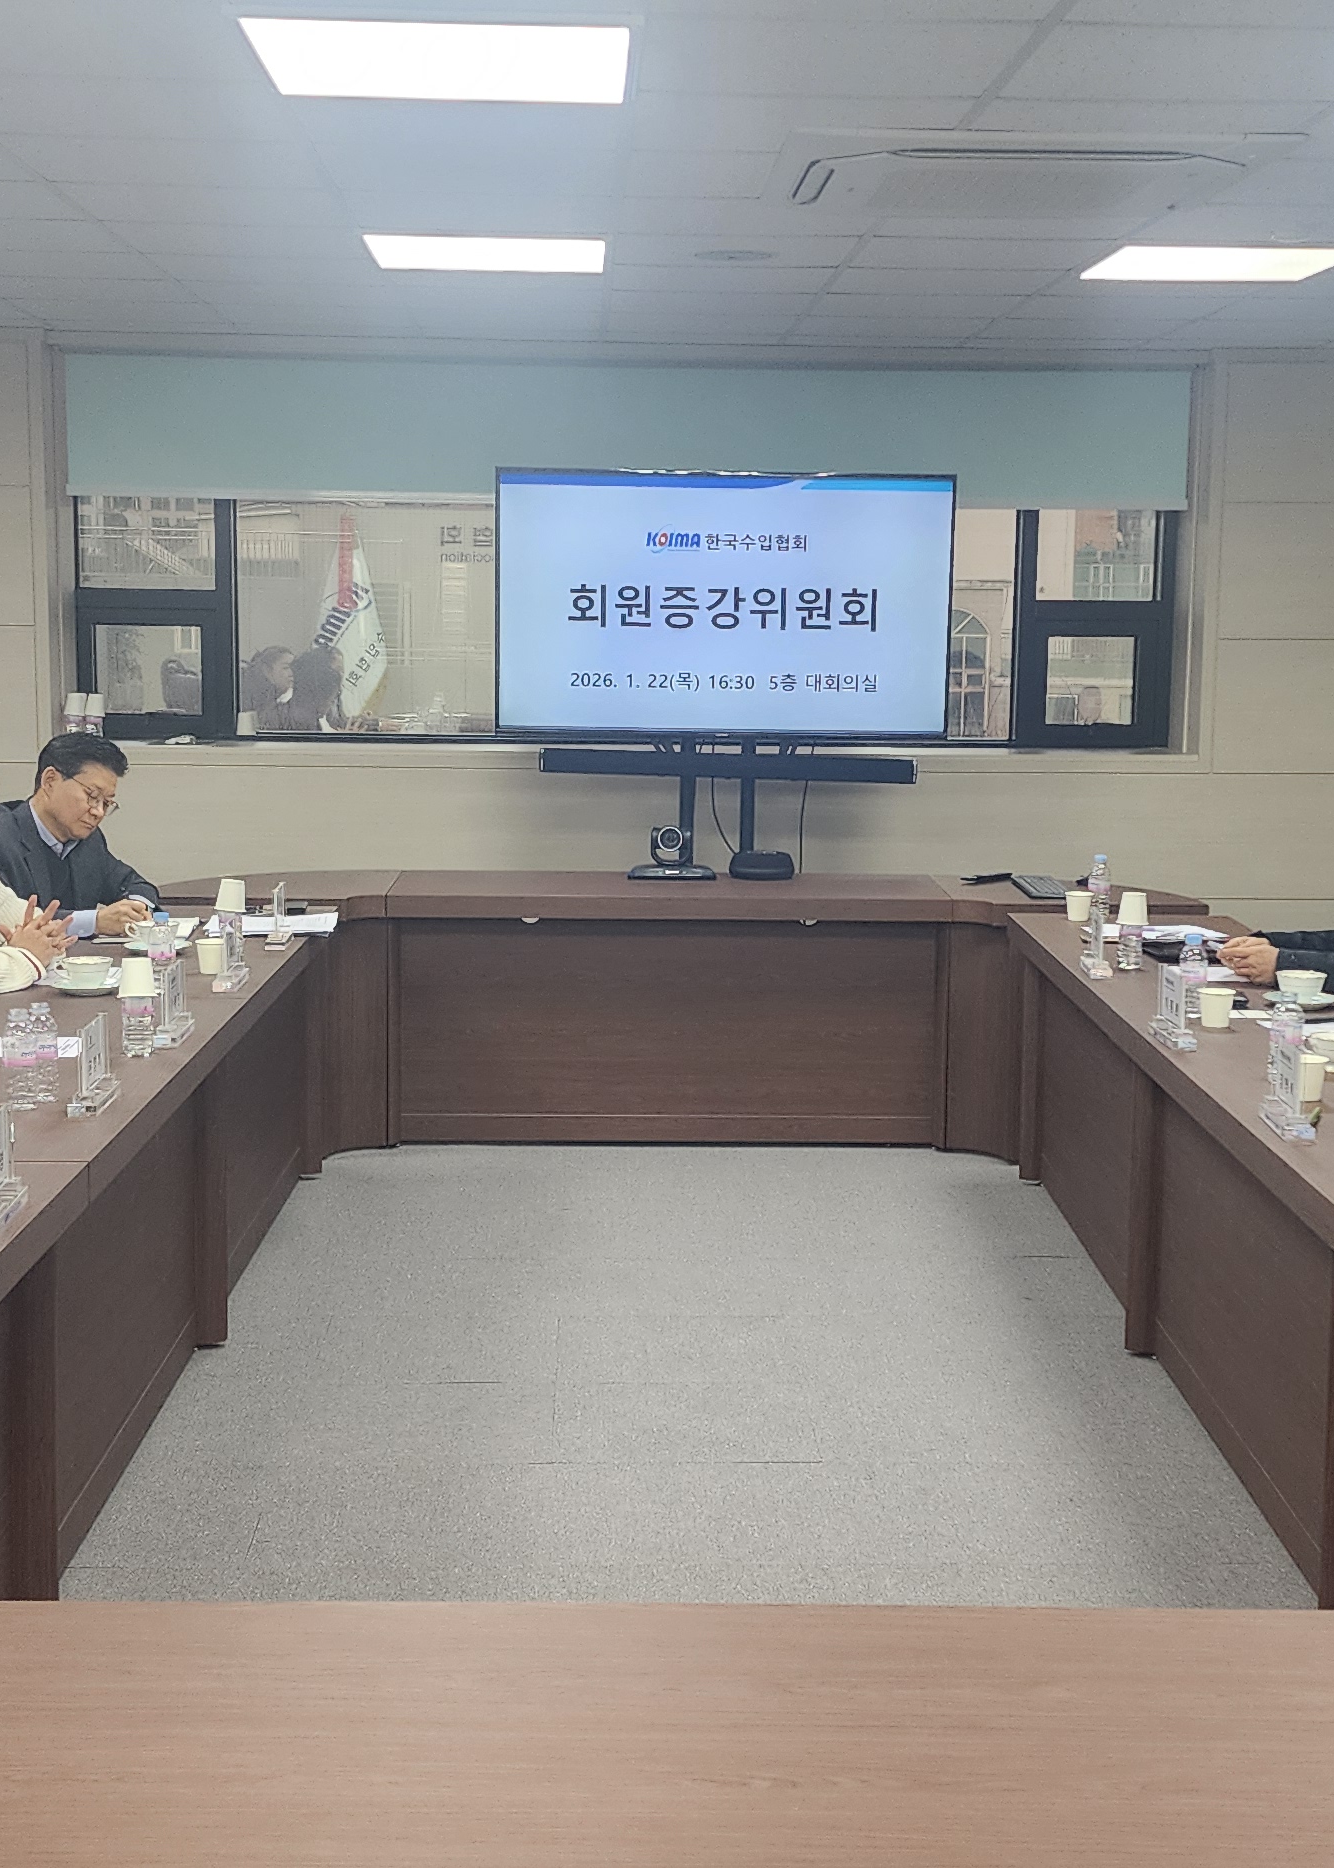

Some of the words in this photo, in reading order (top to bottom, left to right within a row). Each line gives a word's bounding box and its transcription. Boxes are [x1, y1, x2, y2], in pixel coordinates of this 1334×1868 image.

[645, 530, 701, 552] KOIMA
[704, 532, 809, 553] 한국수입협회
[567, 583, 879, 633] 회원증강위원회
[570, 672, 618, 689] 2026.
[626, 673, 641, 689] 1.
[647, 672, 700, 692] 22(목)
[708, 674, 755, 690] 16:30
[769, 673, 798, 692] 5층
[805, 673, 879, 693] 대회의실
